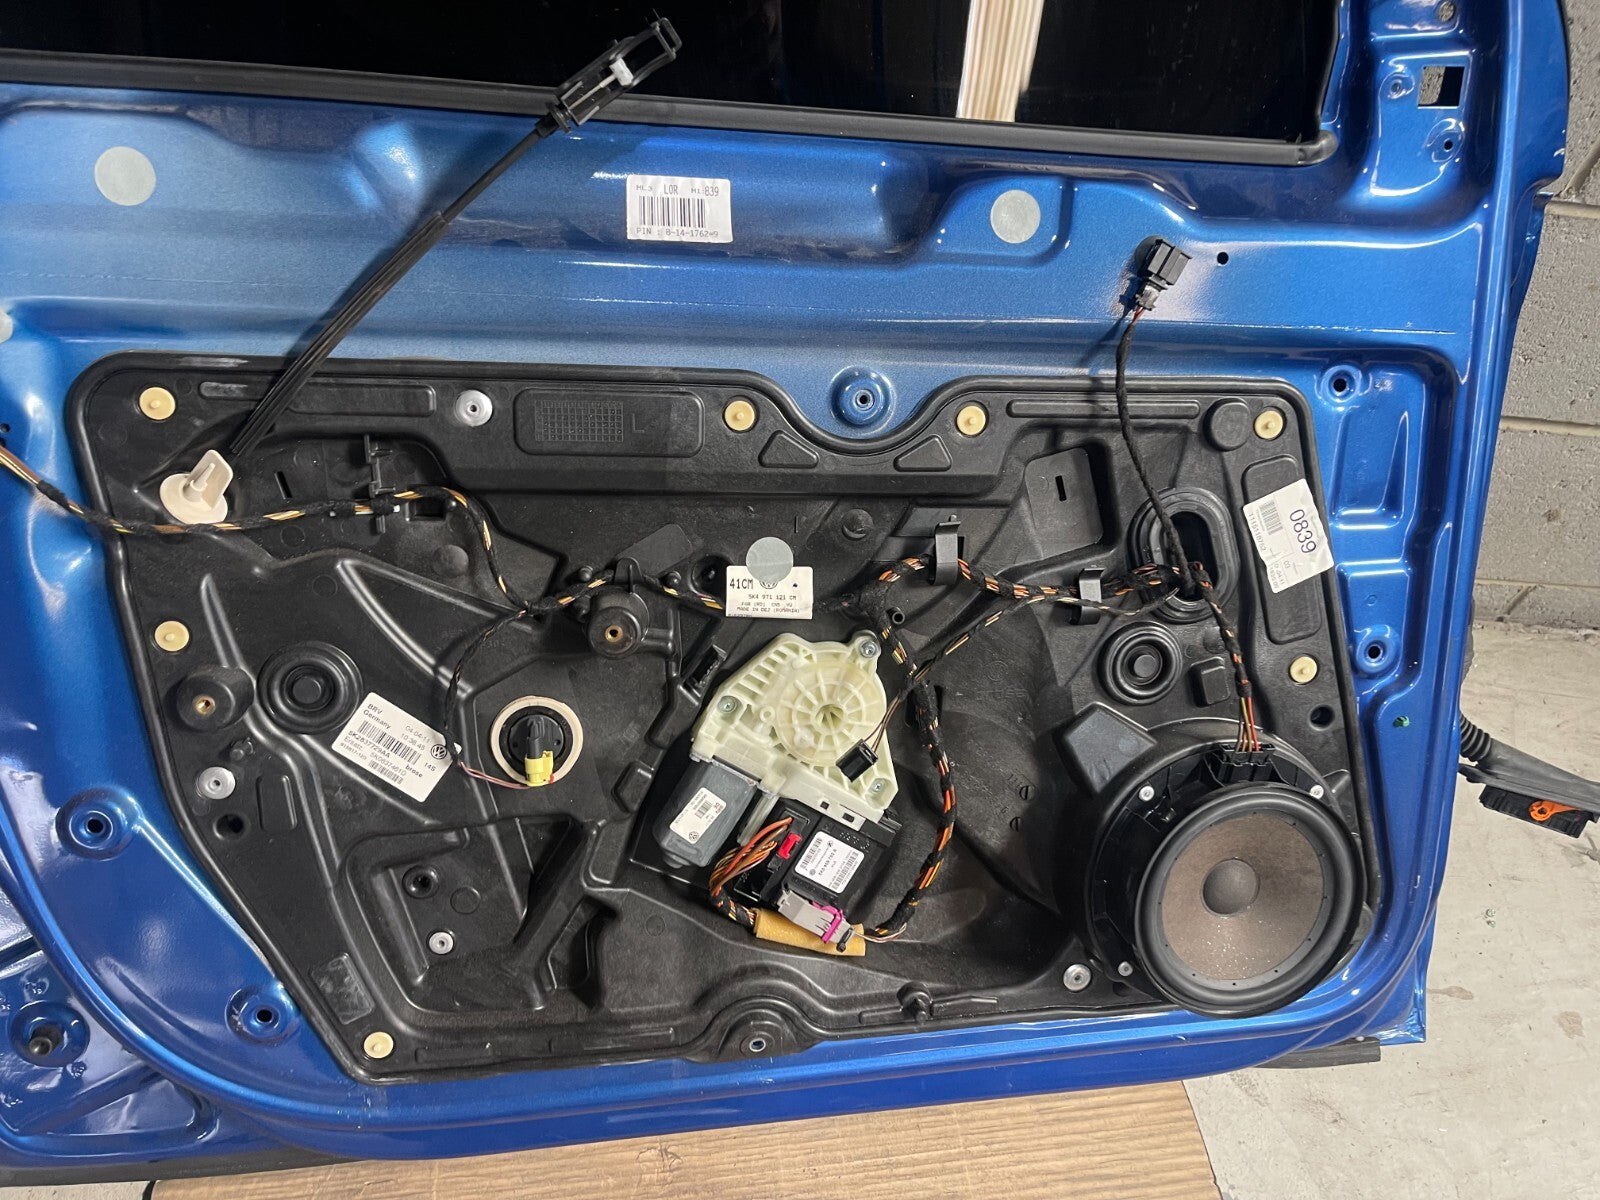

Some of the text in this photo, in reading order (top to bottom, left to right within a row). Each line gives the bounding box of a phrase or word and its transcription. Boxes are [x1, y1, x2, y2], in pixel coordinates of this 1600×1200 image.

[664, 184, 679, 195] LOR
[1289, 509, 1317, 553] 0839
[729, 578, 754, 589] 41CM
[367, 703, 383, 715] BRV
[363, 709, 391, 729] Germany
[405, 764, 424, 778] brose
